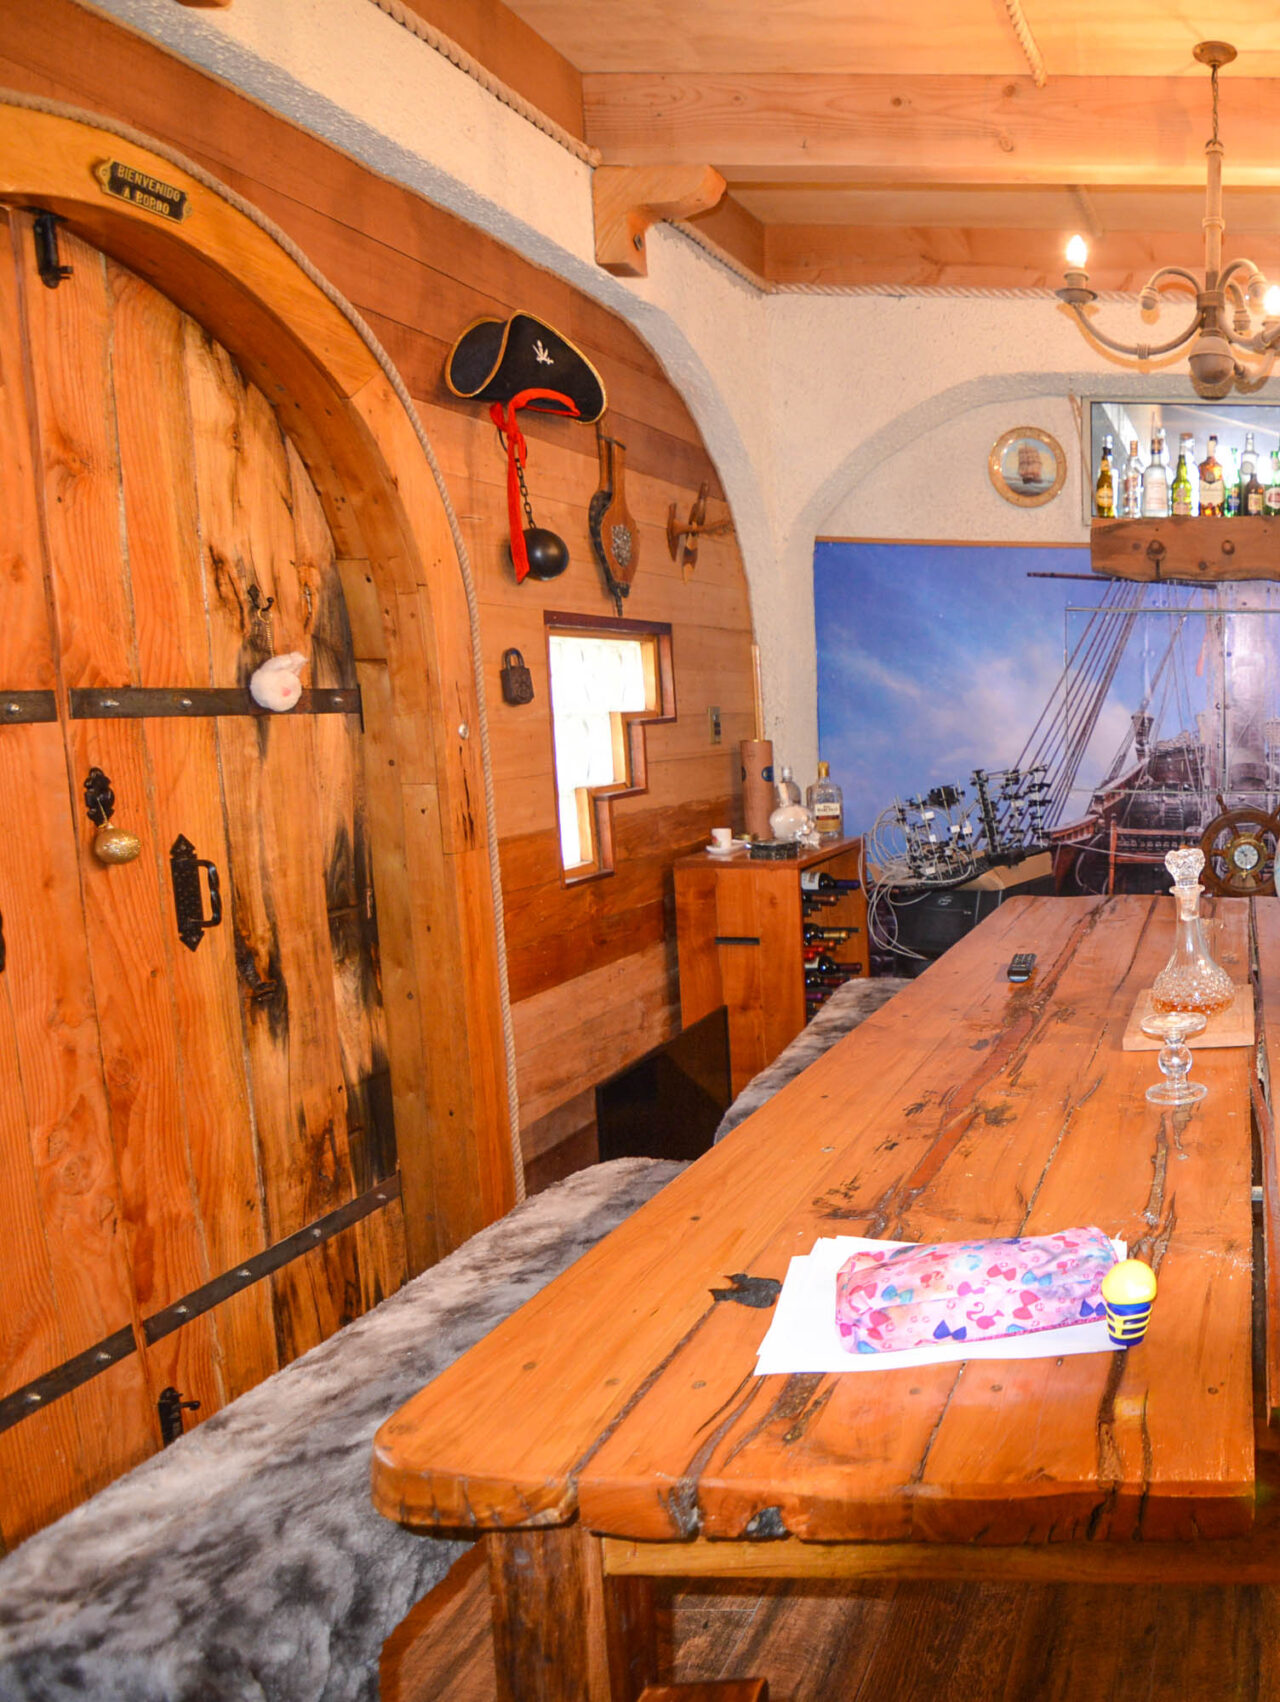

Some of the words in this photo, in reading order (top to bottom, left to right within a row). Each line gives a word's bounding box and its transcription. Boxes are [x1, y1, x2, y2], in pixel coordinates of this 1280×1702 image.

[117, 165, 180, 201] BIENVENIDO
[123, 187, 130, 198] A
[136, 191, 169, 214] BORDO
